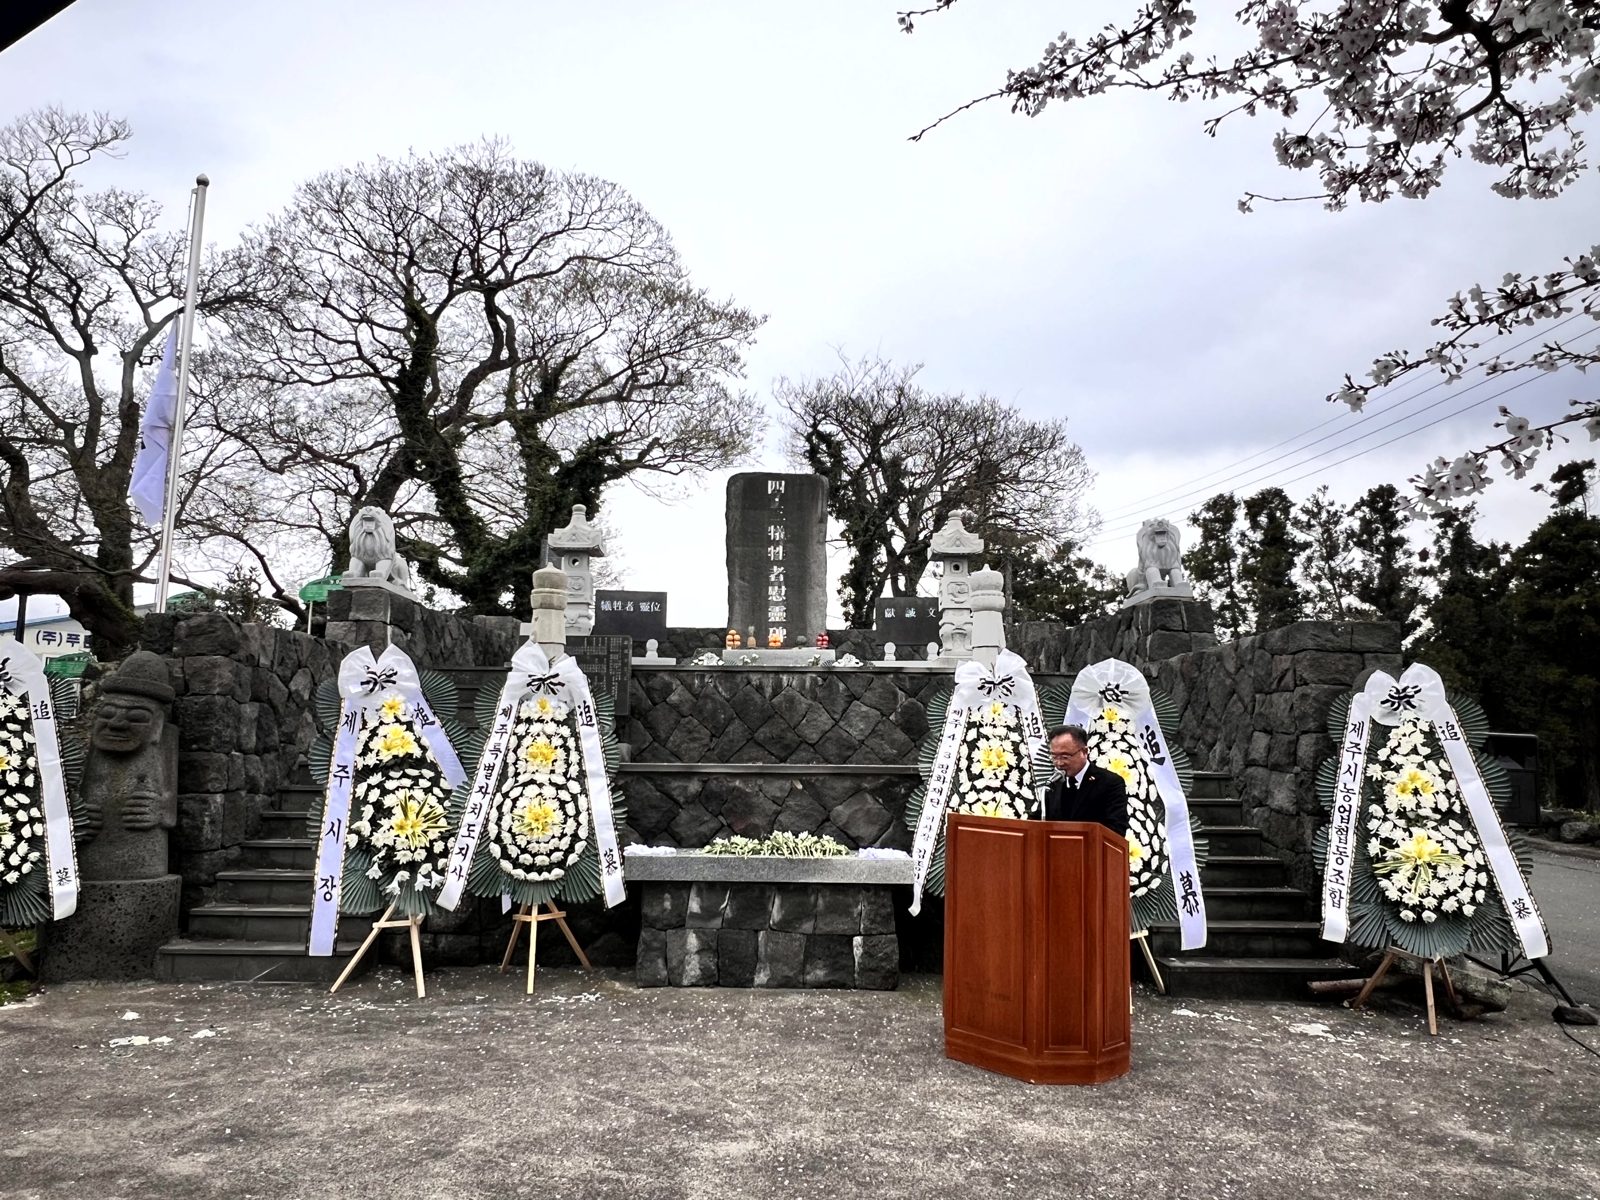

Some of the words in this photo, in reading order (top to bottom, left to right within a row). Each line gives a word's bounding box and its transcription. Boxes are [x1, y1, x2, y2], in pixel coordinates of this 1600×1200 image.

[33, 701, 51, 721] 追
[410, 702, 436, 729] 追
[577, 700, 595, 728] 追
[1025, 712, 1043, 739] 追
[1438, 721, 1461, 742] 追
[1140, 725, 1165, 766] 追
[318, 710, 358, 902] 제주시장
[450, 703, 513, 881] 제주특별자치도지사
[1328, 720, 1365, 908] 제주시농업협동조합
